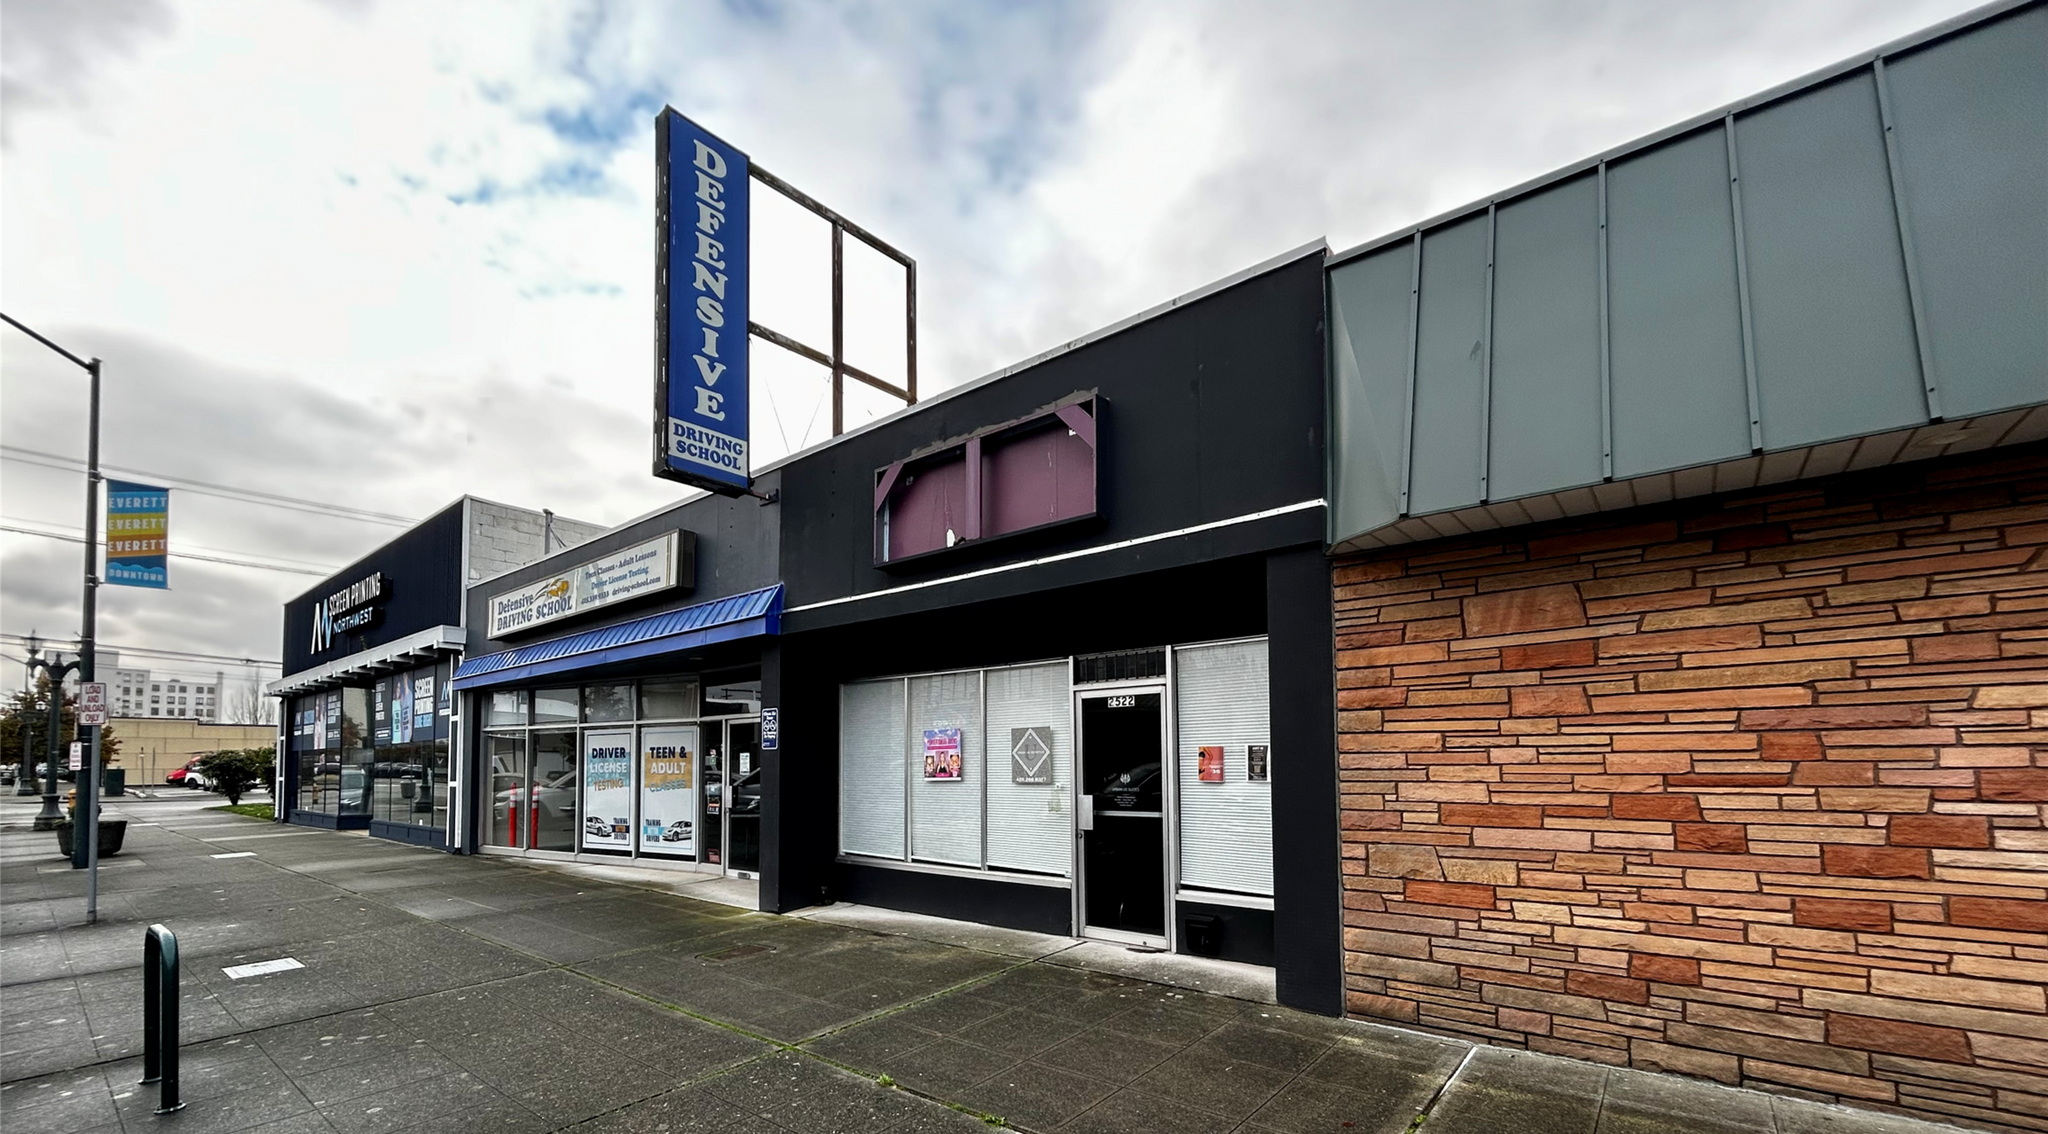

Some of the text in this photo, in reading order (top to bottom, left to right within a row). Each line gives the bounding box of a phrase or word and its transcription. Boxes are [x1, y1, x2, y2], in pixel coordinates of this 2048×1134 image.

[692, 139, 728, 421] DEFENSIVE
[673, 422, 743, 456] DRIVING
[676, 440, 741, 470] SCHOOL
[108, 497, 167, 508] EVERETT
[108, 518, 166, 530] EVERETT
[108, 539, 166, 551] EVERETT
[597, 564, 615, 576] Classes
[618, 556, 634, 569] Adult
[635, 549, 657, 562] Lessons
[109, 569, 163, 581] DOWNTOWN
[591, 566, 649, 591] Driver License Testing
[329, 571, 380, 616] SCREEN PRINTING
[498, 594, 534, 615] Defensive
[497, 595, 573, 631] DRIVING SCHOOL
[333, 606, 373, 634] NORTHWEST
[85, 685, 101, 694] LOAD
[414, 675, 434, 699] SCREEN
[87, 695, 99, 703] AND
[1108, 696, 1135, 708] 2522
[81, 704, 105, 713] UNLOAD
[85, 714, 100, 722] ONLY
[592, 747, 626, 759] DRIVER
[650, 746, 687, 759] TEEN &
[590, 762, 627, 773] LICENSE
[651, 762, 686, 774] ADULT
[593, 778, 624, 791] TESTING
[649, 780, 686, 792] CLASSES
